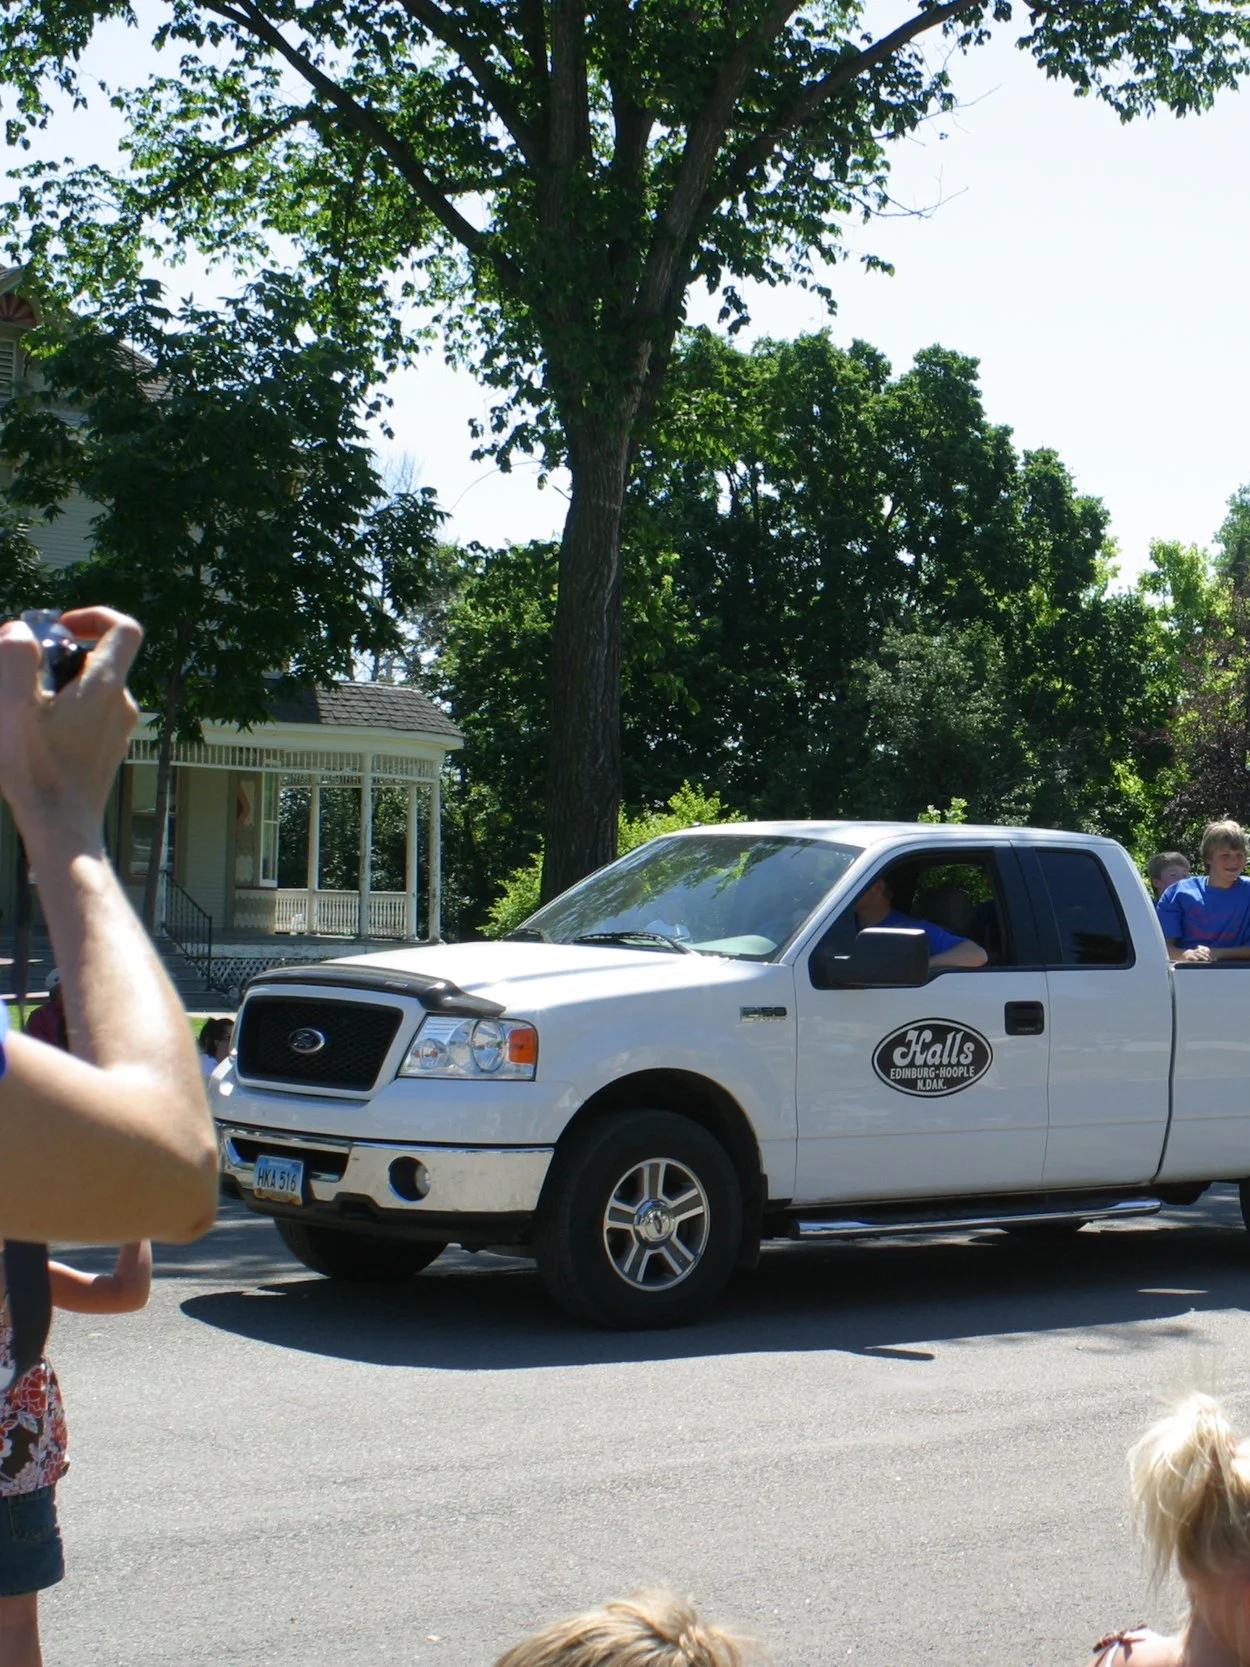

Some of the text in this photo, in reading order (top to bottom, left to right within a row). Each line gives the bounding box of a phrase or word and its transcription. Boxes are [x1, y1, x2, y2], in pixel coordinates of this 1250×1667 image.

[893, 1029, 975, 1067] Halls
[890, 1066, 975, 1080] EDINBURG-HOOPLE
[279, 1170, 297, 1191] 516
